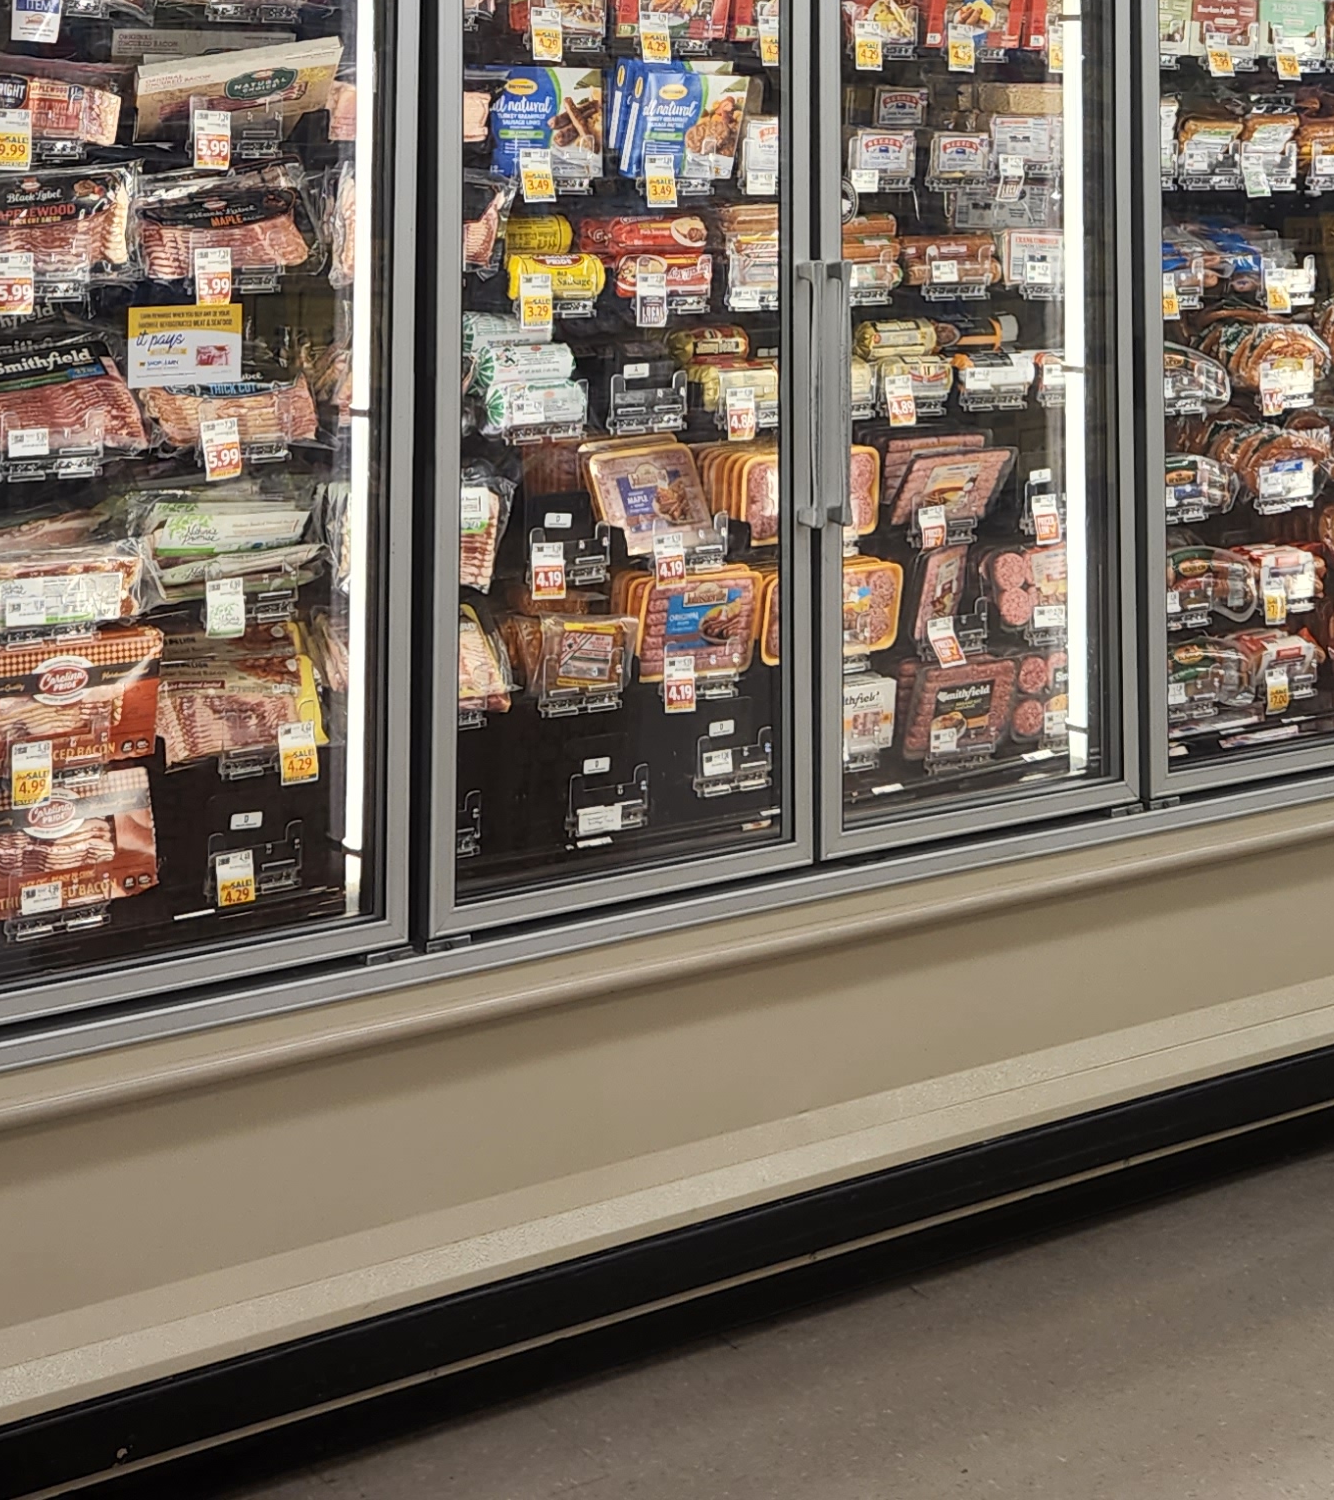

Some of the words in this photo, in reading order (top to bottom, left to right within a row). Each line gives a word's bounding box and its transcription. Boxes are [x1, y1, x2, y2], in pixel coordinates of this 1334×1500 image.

[538, 37, 558, 51] 4.29
[646, 39, 667, 53] 4.29
[234, 77, 286, 91] NATURAL
[508, 94, 552, 114] natural
[656, 100, 697, 117] natural
[197, 141, 229, 156] 5.99
[527, 179, 550, 191] 3.49
[651, 184, 672, 197] 3.49
[210, 215, 243, 227] MAPLE
[198, 278, 231, 294] 5.99
[527, 305, 549, 318] 3.29
[148, 332, 185, 352] pays
[209, 383, 238, 394] THICK
[890, 401, 916, 415] 4.89
[209, 450, 239, 467] 5.99
[659, 561, 684, 580] 4.19
[536, 570, 562, 589] 4.19
[40, 670, 87, 688] Carolina
[54, 679, 77, 691] PRIDE
[668, 682, 693, 701] 4.19
[77, 742, 115, 757] BACON
[287, 757, 312, 773] 4.29
[19, 779, 46, 795] 4.99
[78, 879, 117, 895] BACON
[224, 889, 250, 903] 4.29
